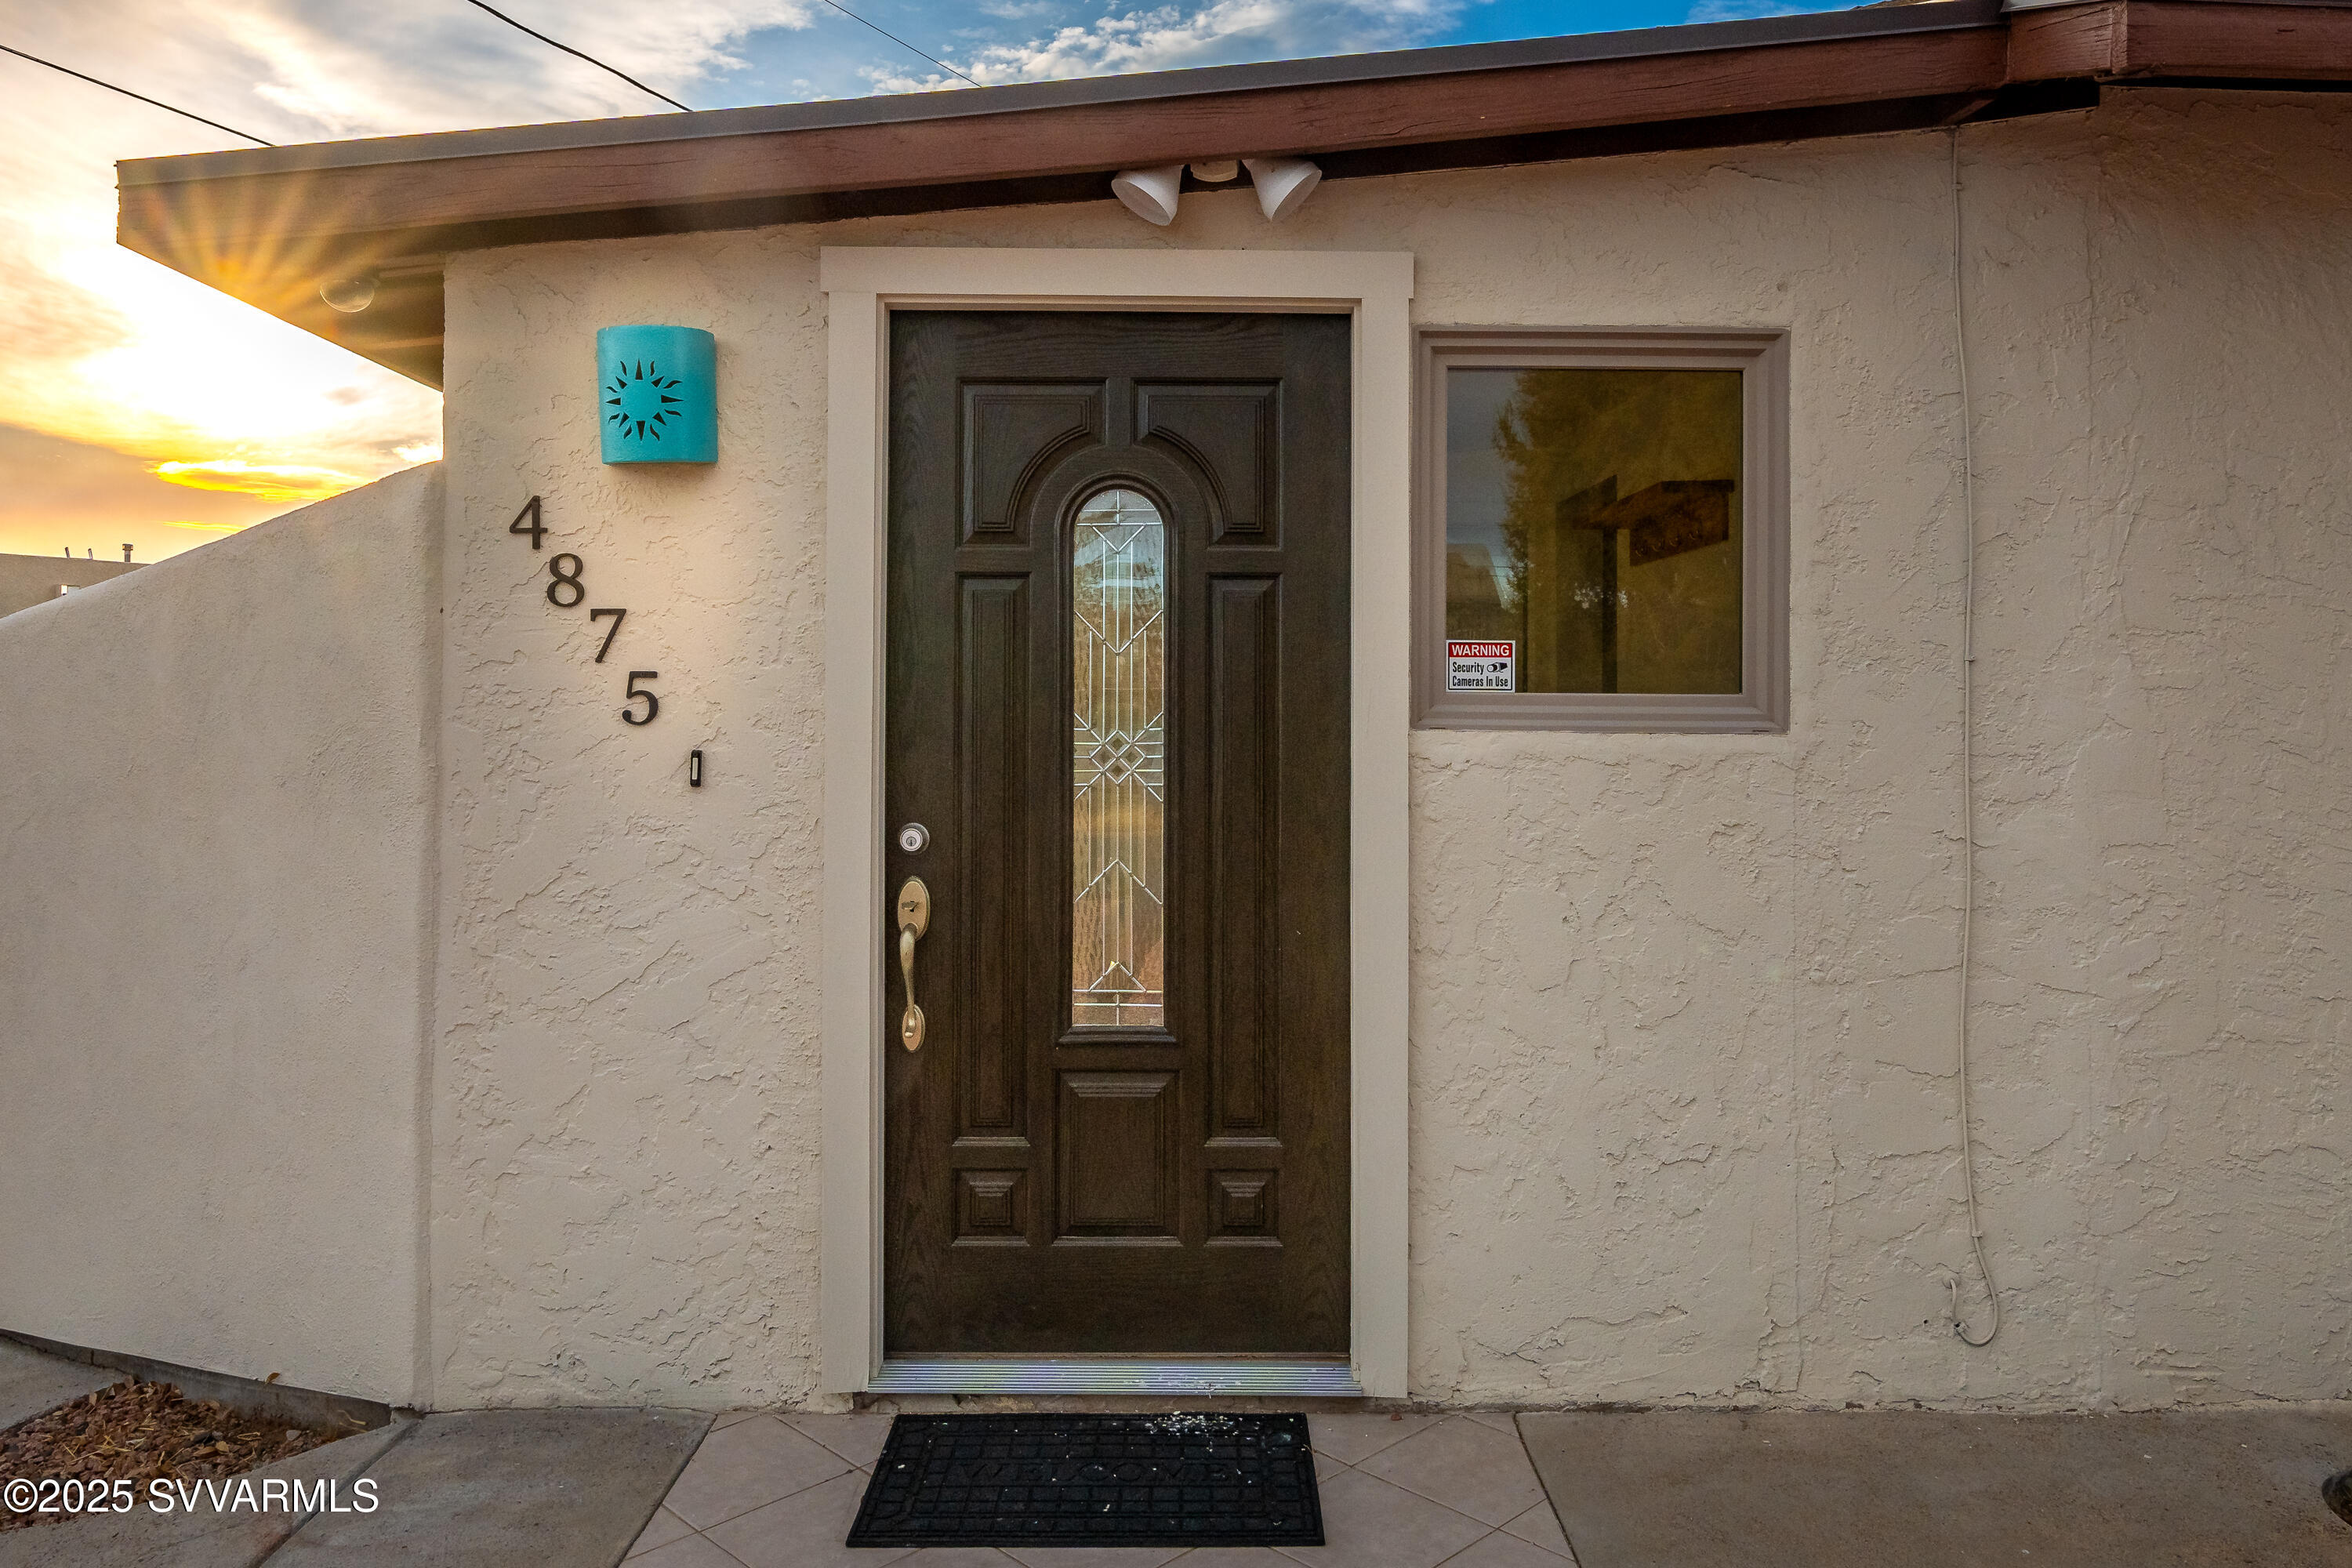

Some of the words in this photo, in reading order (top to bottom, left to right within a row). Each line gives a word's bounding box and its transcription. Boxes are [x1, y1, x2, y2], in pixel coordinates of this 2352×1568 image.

[1451, 644, 1510, 656] WARNING
[1452, 661, 1485, 675] Security
[1452, 675, 1484, 687] Cameras
[1486, 676, 1493, 687] In
[1495, 676, 1508, 687] Use
[958, 1462, 1229, 1483] WELCOME
